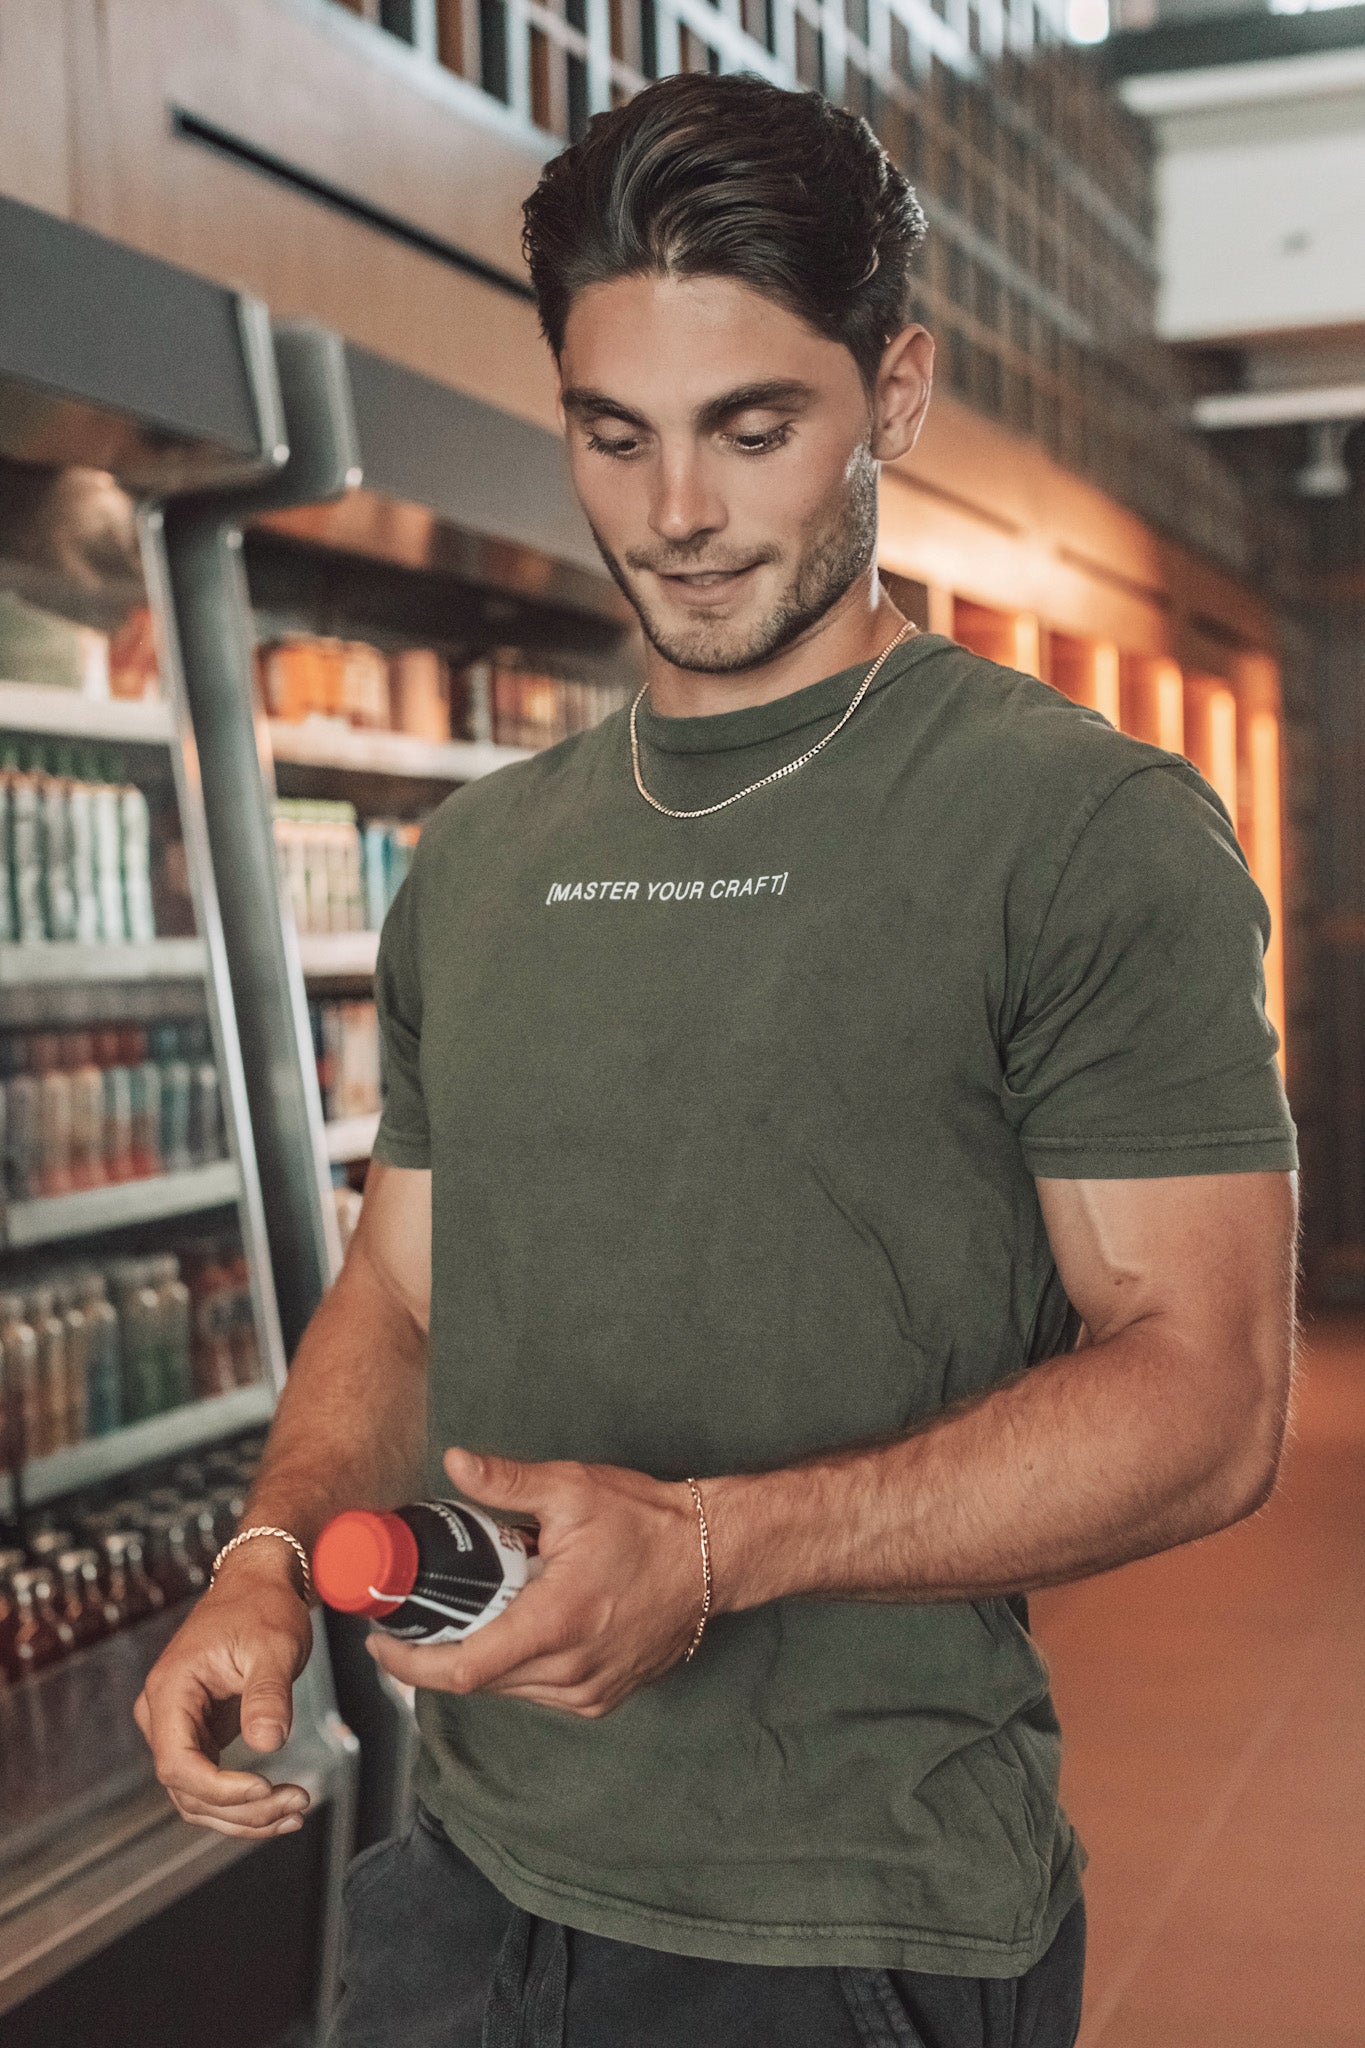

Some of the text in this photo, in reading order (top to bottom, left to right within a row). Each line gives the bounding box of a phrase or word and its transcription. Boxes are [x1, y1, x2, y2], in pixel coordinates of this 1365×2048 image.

[546, 872, 788, 905] [MASTER YOUR CRAFT]
